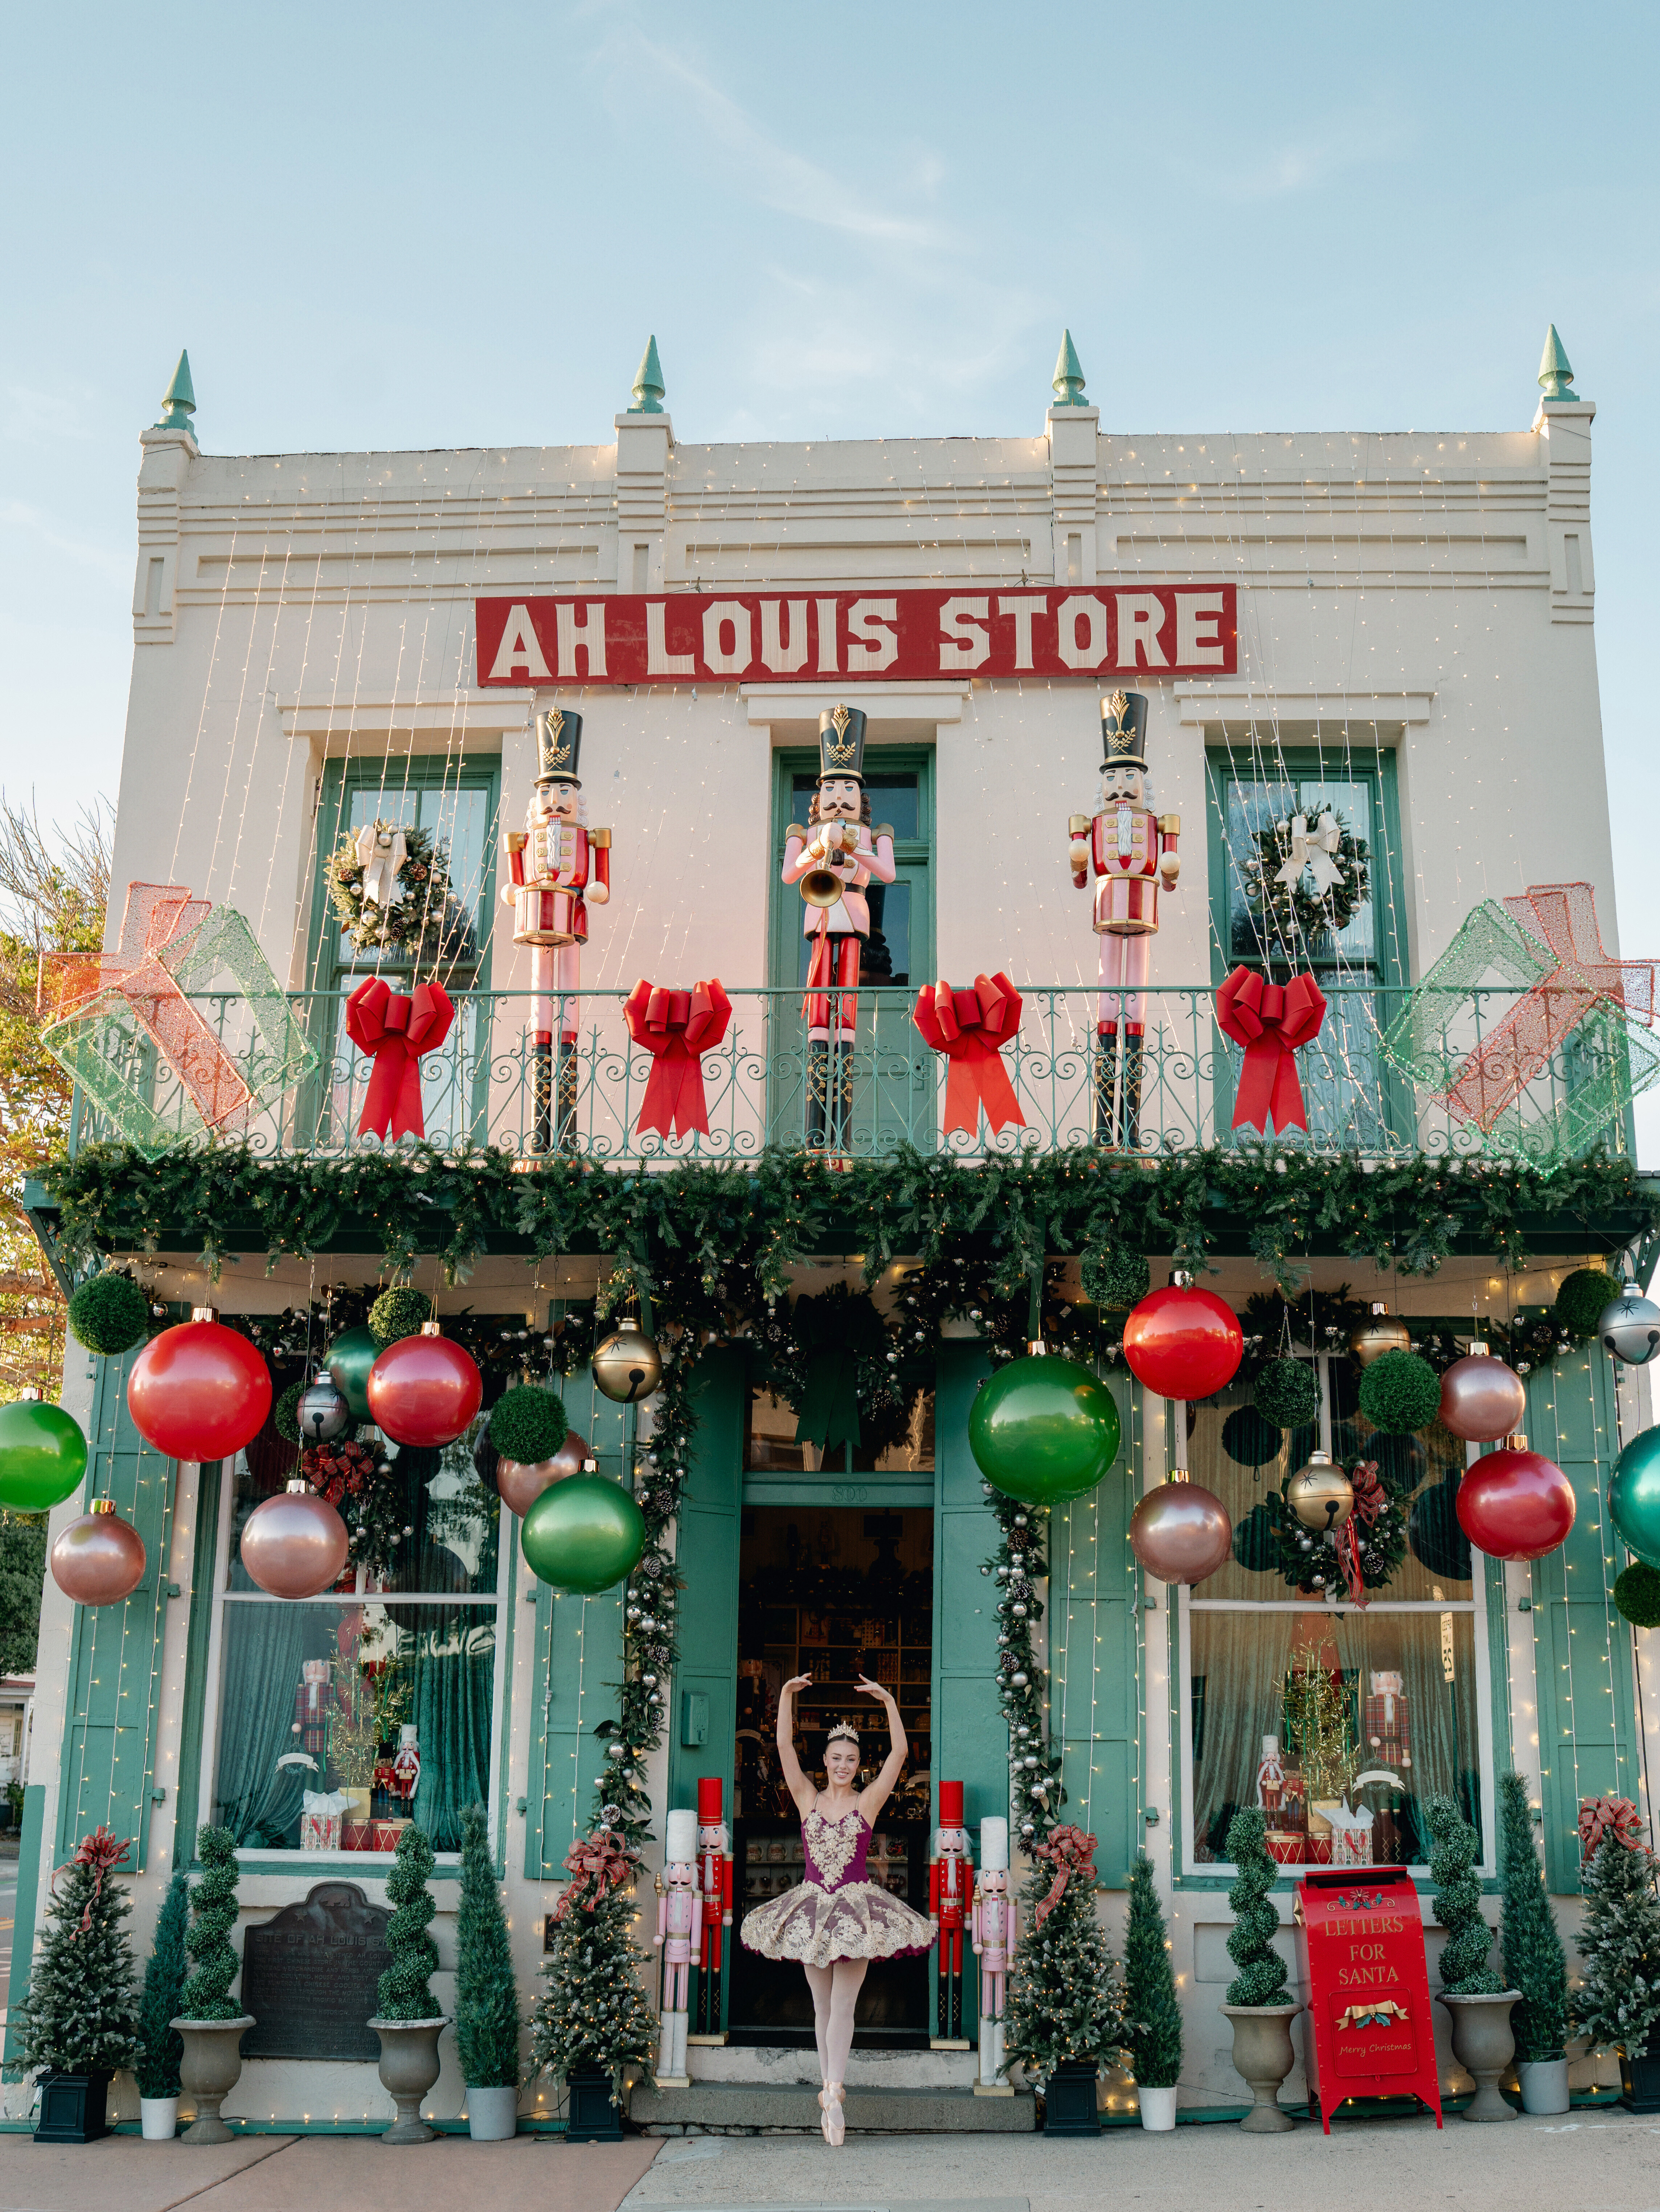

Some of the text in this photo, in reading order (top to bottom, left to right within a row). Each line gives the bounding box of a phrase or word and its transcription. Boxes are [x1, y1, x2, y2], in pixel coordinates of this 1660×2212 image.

[488, 592, 1224, 678] AH LOUIS STORE
[832, 1486, 867, 1502] 800
[1326, 1916, 1403, 1936] LETTERS
[255, 1934, 281, 1943] SITE
[288, 1935, 303, 1943] OF
[309, 1935, 324, 1944] AH
[330, 1936, 366, 1945] LOUIS
[1349, 1944, 1387, 1961] FOR
[1339, 1966, 1399, 1985] SANTA
[1339, 2043, 1411, 2057] Merry Christmas
